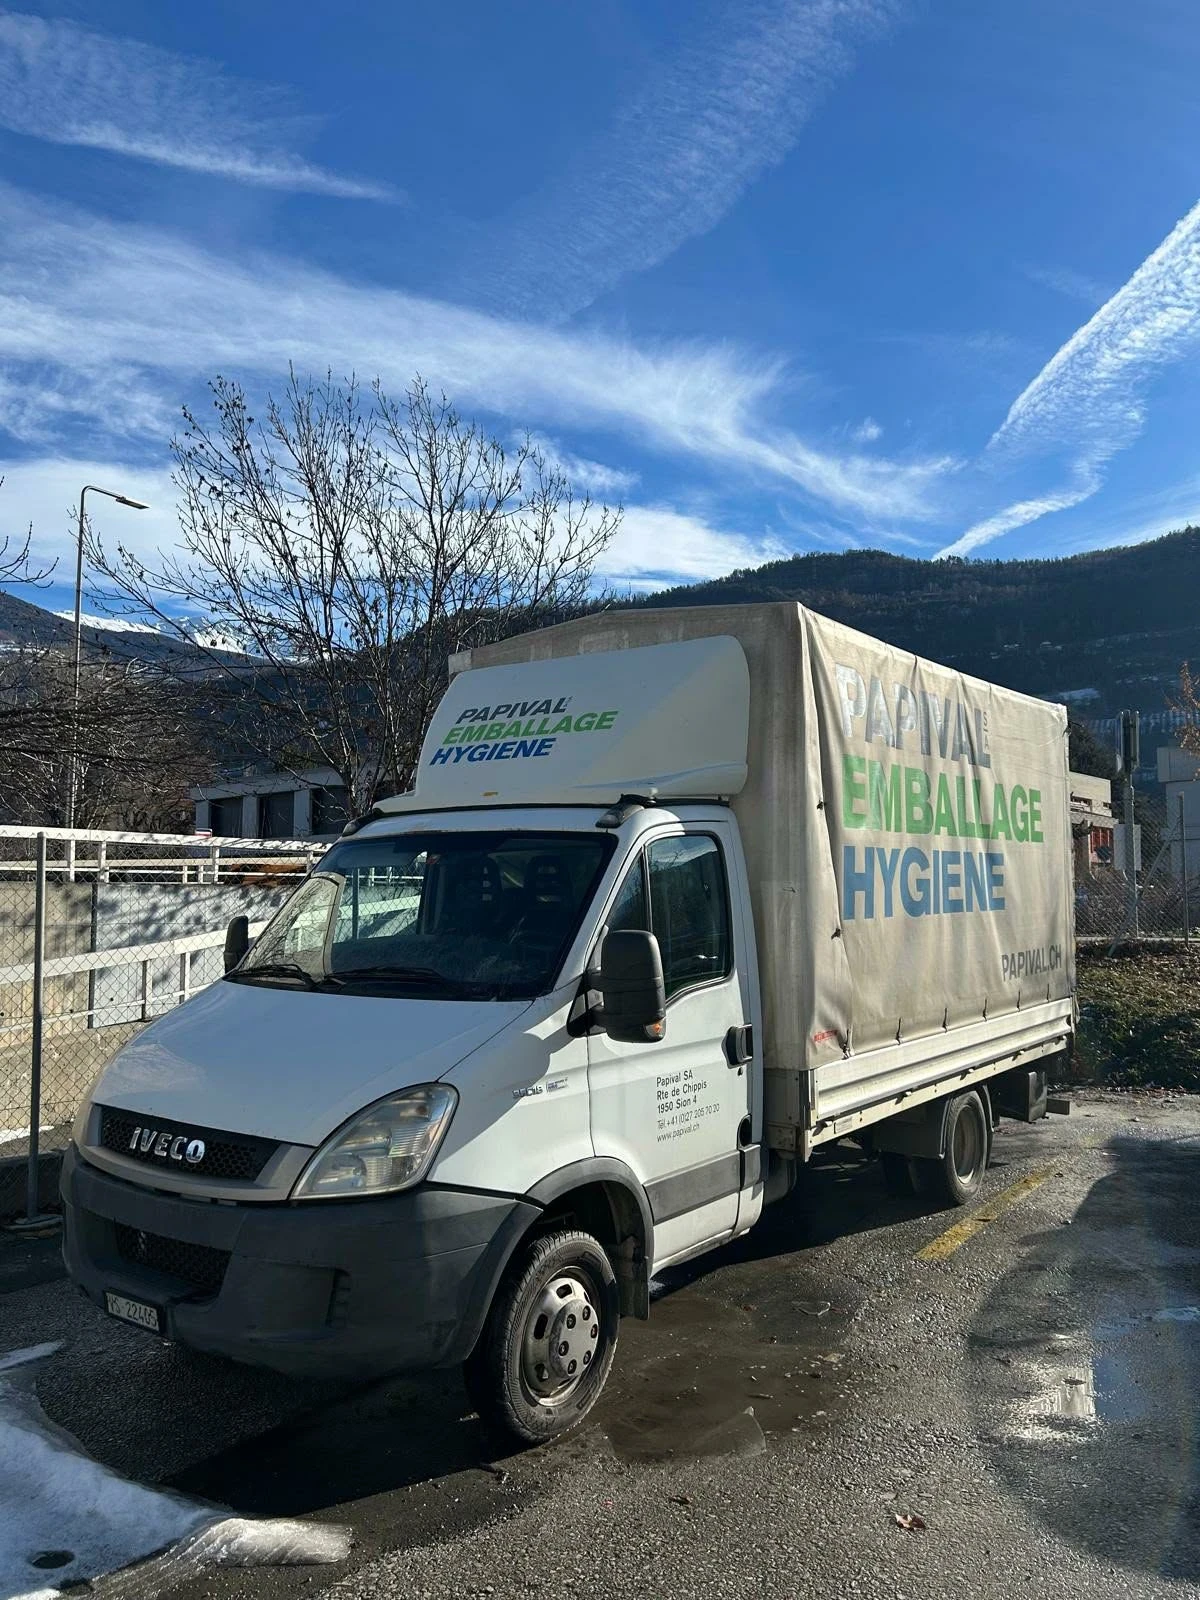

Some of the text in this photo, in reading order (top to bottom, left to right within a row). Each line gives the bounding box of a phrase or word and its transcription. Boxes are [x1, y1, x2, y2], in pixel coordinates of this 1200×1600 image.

[455, 697, 566, 724] PAPIVAL
[835, 663, 991, 768] PAPIVAL
[442, 711, 619, 745] EMBALLAGE
[429, 738, 557, 766] HYGIENE
[842, 754, 1044, 843] EMBALLAGE
[843, 846, 1006, 920] HYGIENE
[1001, 944, 1062, 981] PAPIVAL.CH
[656, 1069, 693, 1088] Papival SA
[656, 1080, 707, 1101] Rte de Chippis
[657, 1095, 697, 1114] 1950 Sion 4
[129, 1127, 206, 1164] IVECO
[656, 1122, 700, 1143] www.papival.ch
